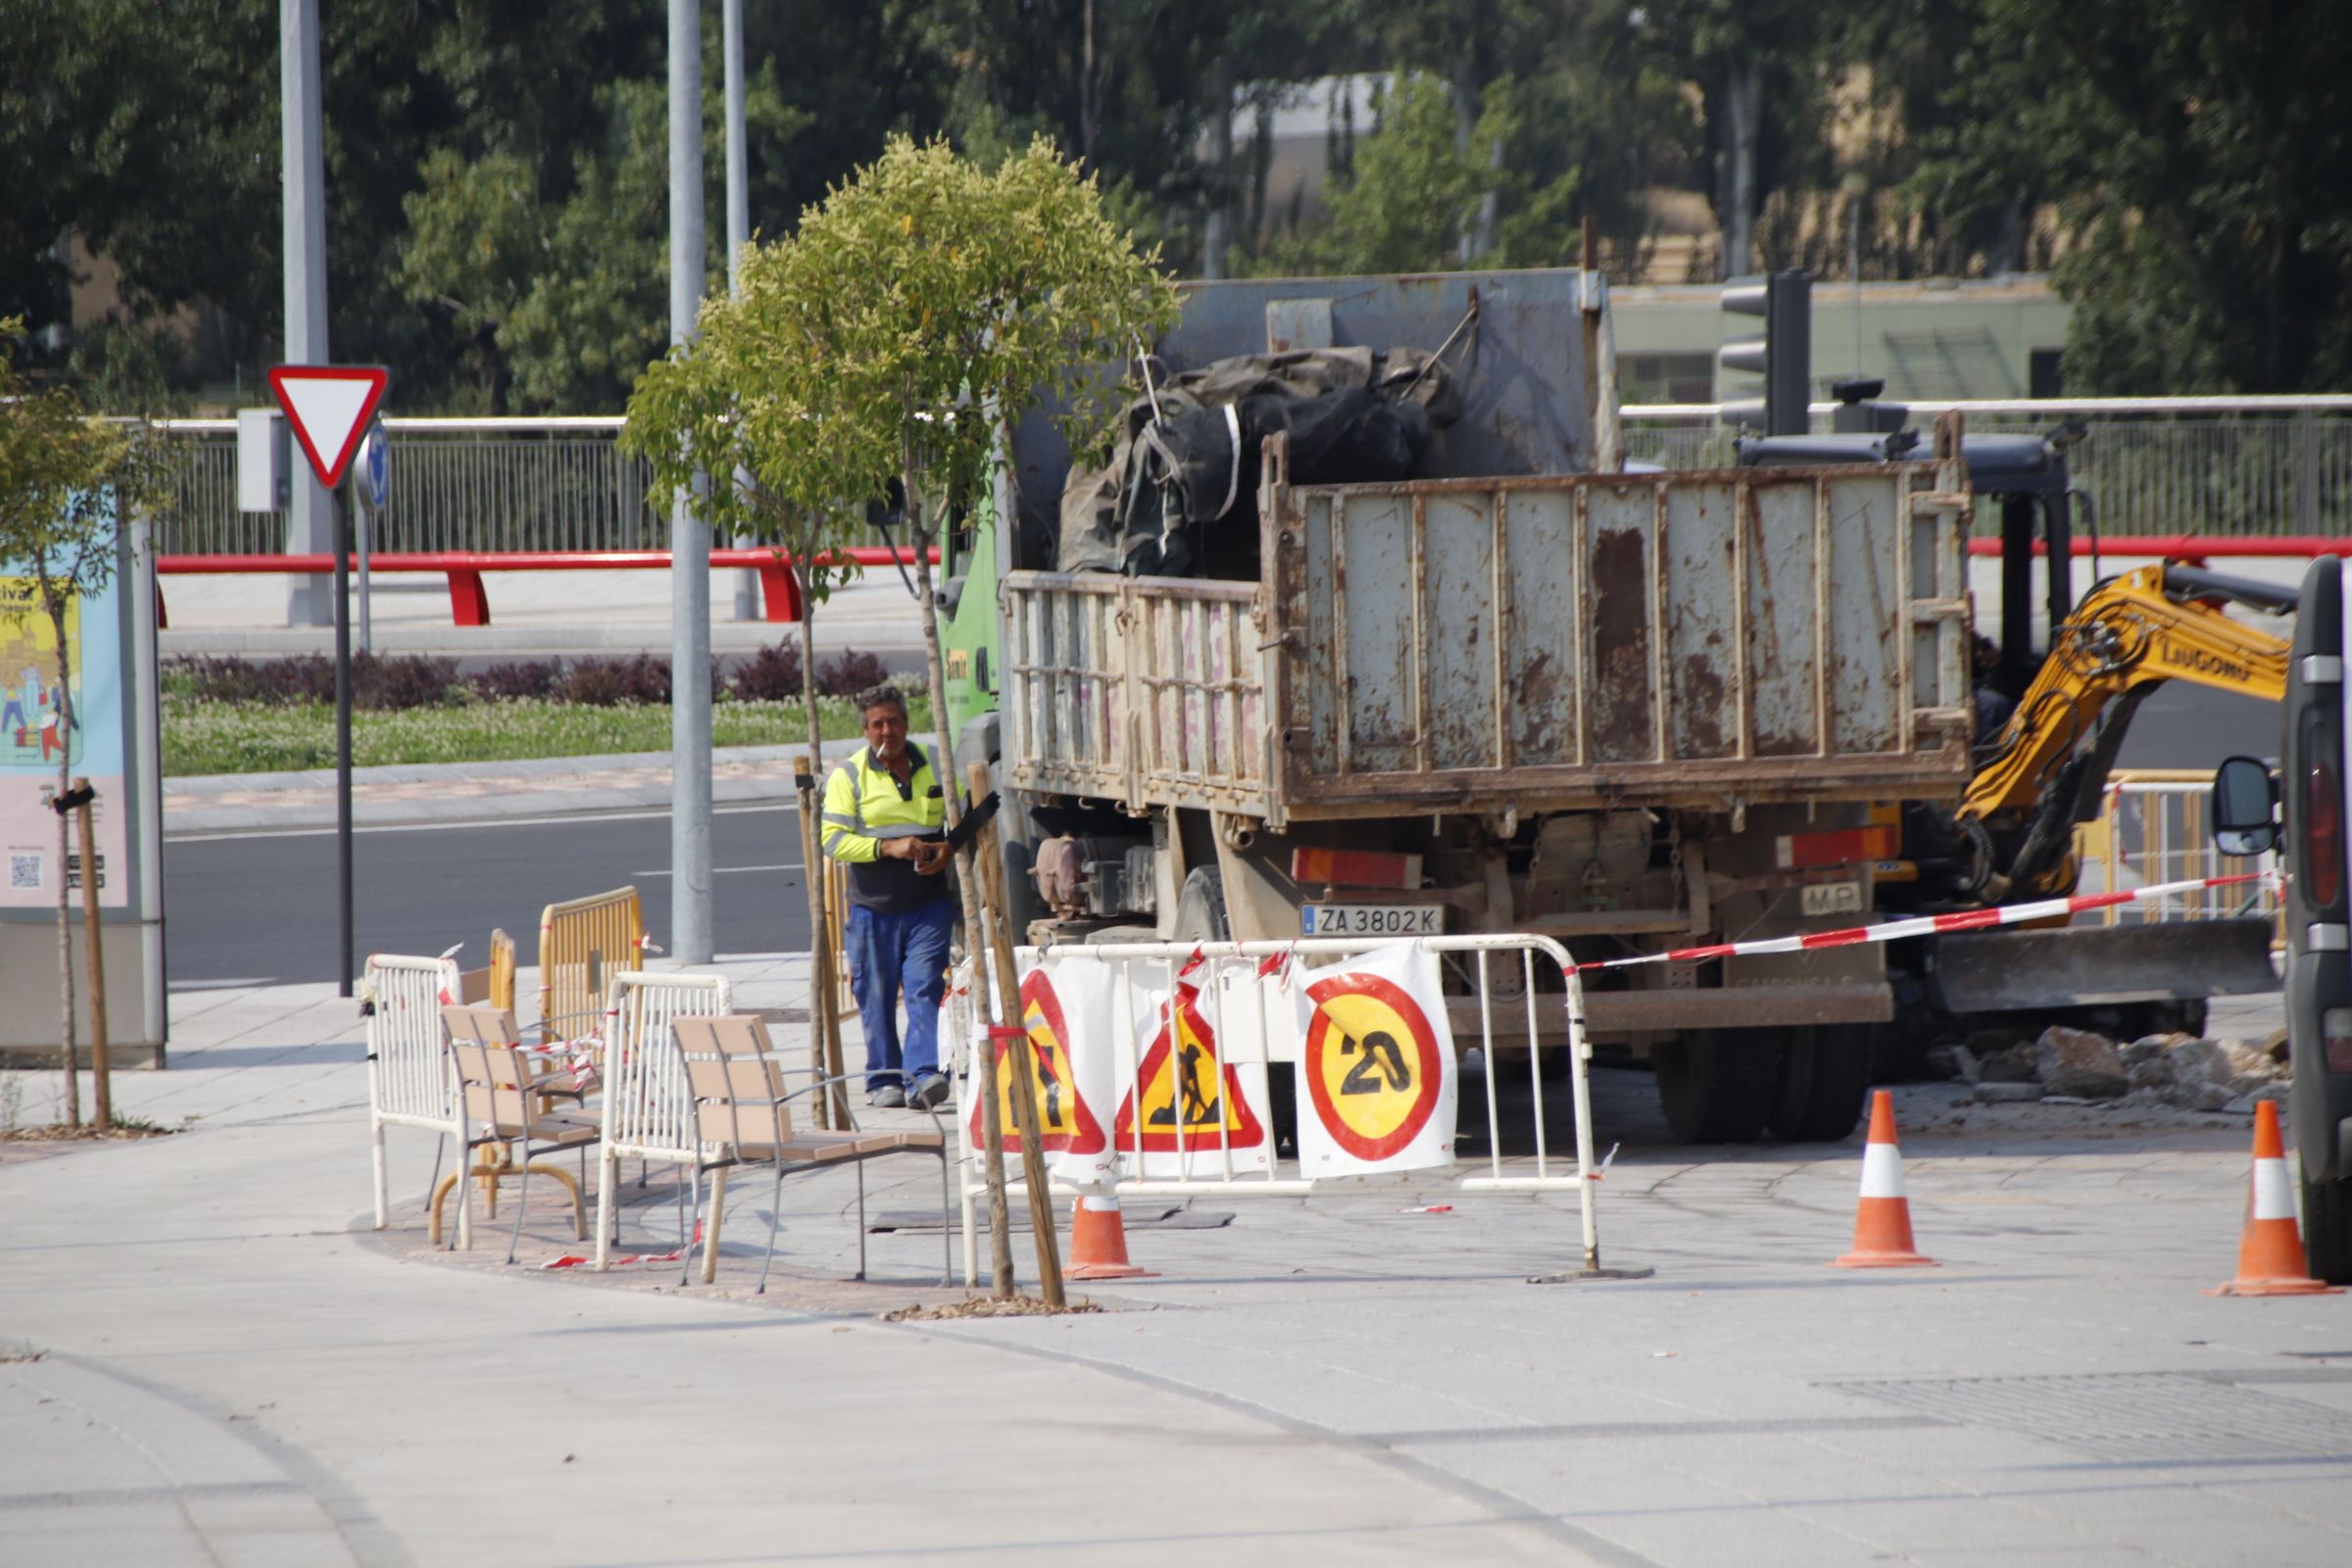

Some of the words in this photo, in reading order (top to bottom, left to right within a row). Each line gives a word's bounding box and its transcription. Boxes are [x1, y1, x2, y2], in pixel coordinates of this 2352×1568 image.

[1321, 909, 1348, 931] ZA
[1355, 910, 1416, 932] 3802
[1421, 909, 1435, 931] K
[1340, 1030, 1411, 1096] 20
